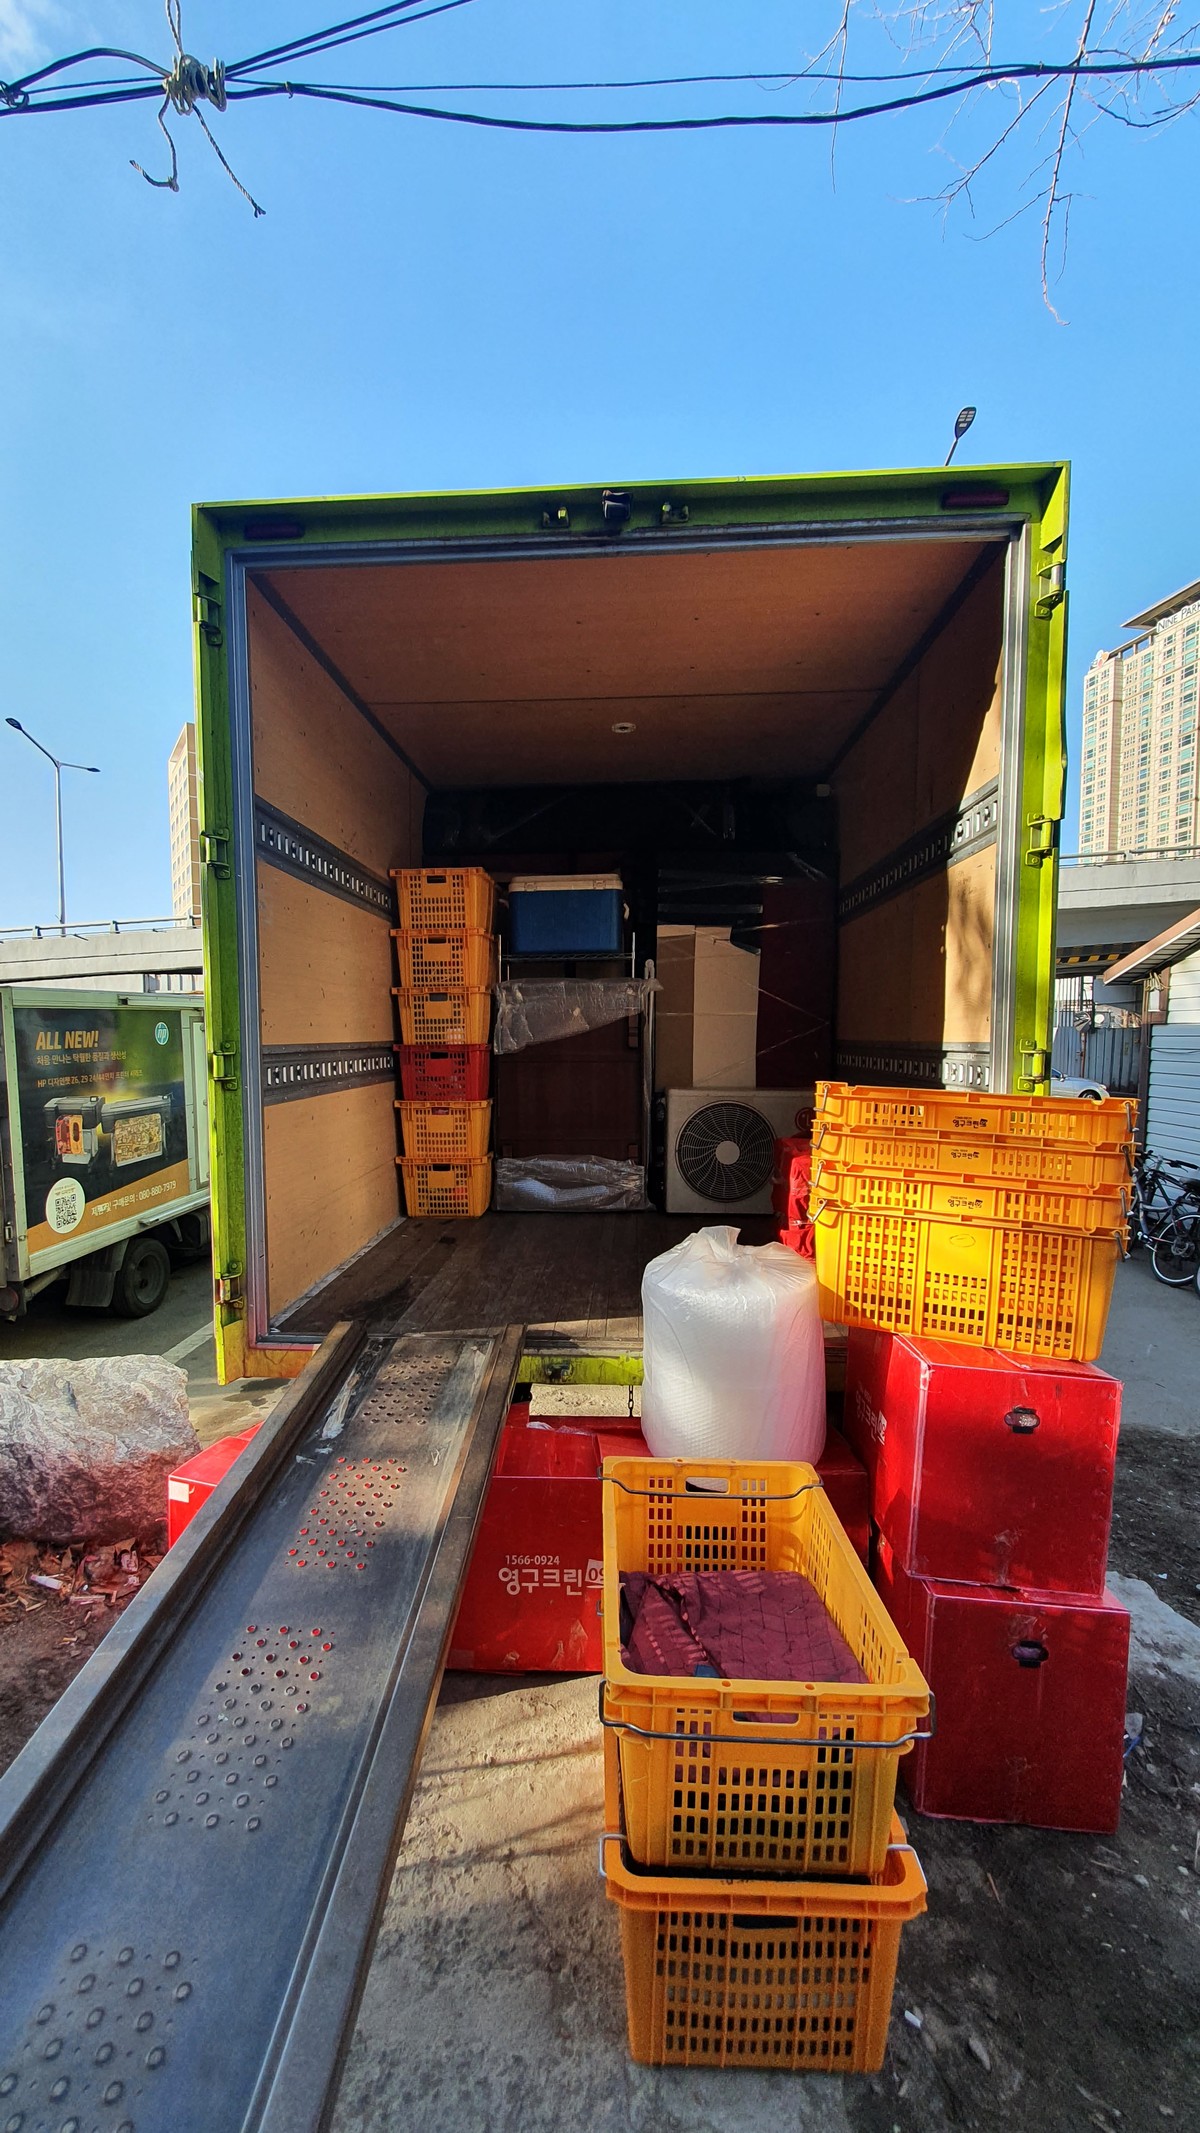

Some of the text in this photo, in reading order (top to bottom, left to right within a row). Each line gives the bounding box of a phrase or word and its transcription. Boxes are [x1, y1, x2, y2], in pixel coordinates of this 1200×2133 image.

[1158, 614, 1178, 631] NINE
[36, 1030, 99, 1051] ALL NEW!
[36, 1055, 51, 1066] 처음
[51, 1053, 72, 1065] 만나는
[37, 1079, 47, 1088] HP
[952, 1119, 980, 1129] 영구크린
[947, 1198, 975, 1209] 영구크린
[505, 1555, 560, 1565] 1566-0924
[498, 1567, 582, 1596] 영구크린
